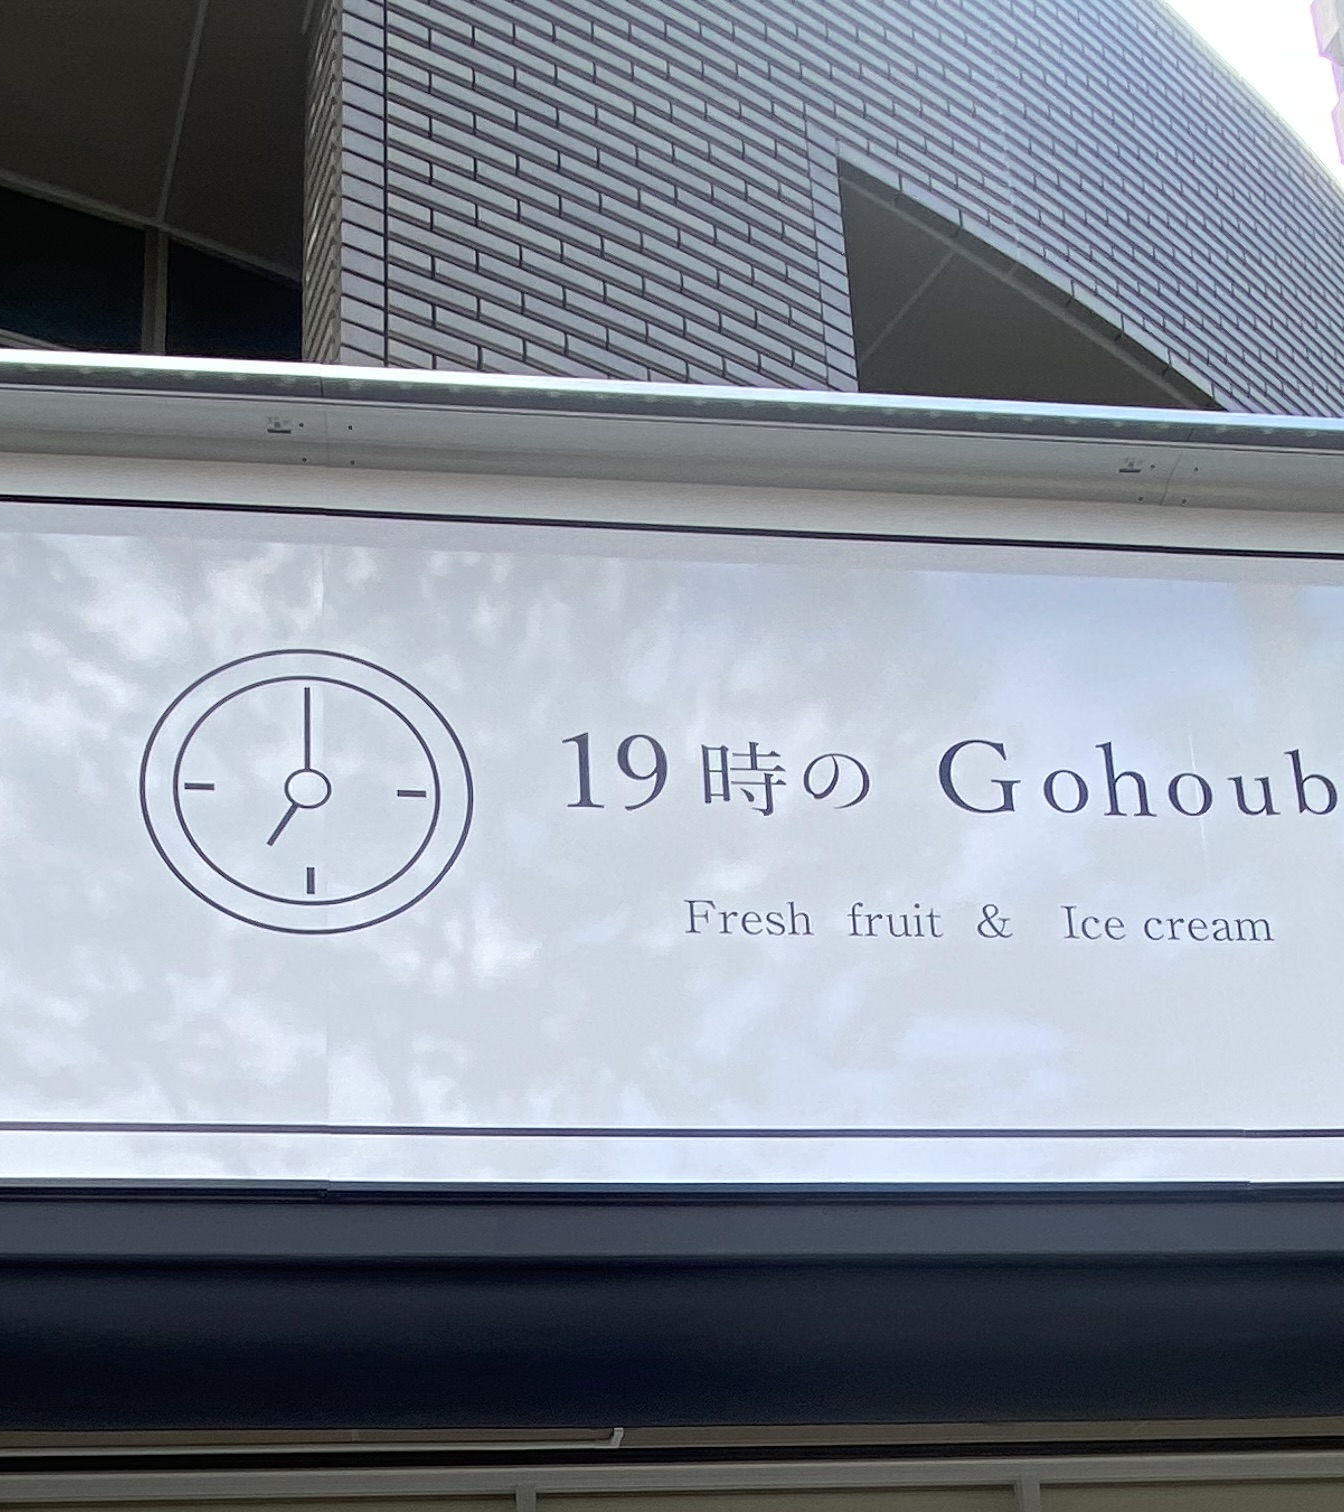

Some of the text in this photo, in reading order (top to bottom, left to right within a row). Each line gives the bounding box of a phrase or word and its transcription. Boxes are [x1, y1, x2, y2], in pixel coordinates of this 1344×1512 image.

[563, 730, 872, 819] 19時の
[684, 899, 1275, 944] Fresh fruit & Ice cream
